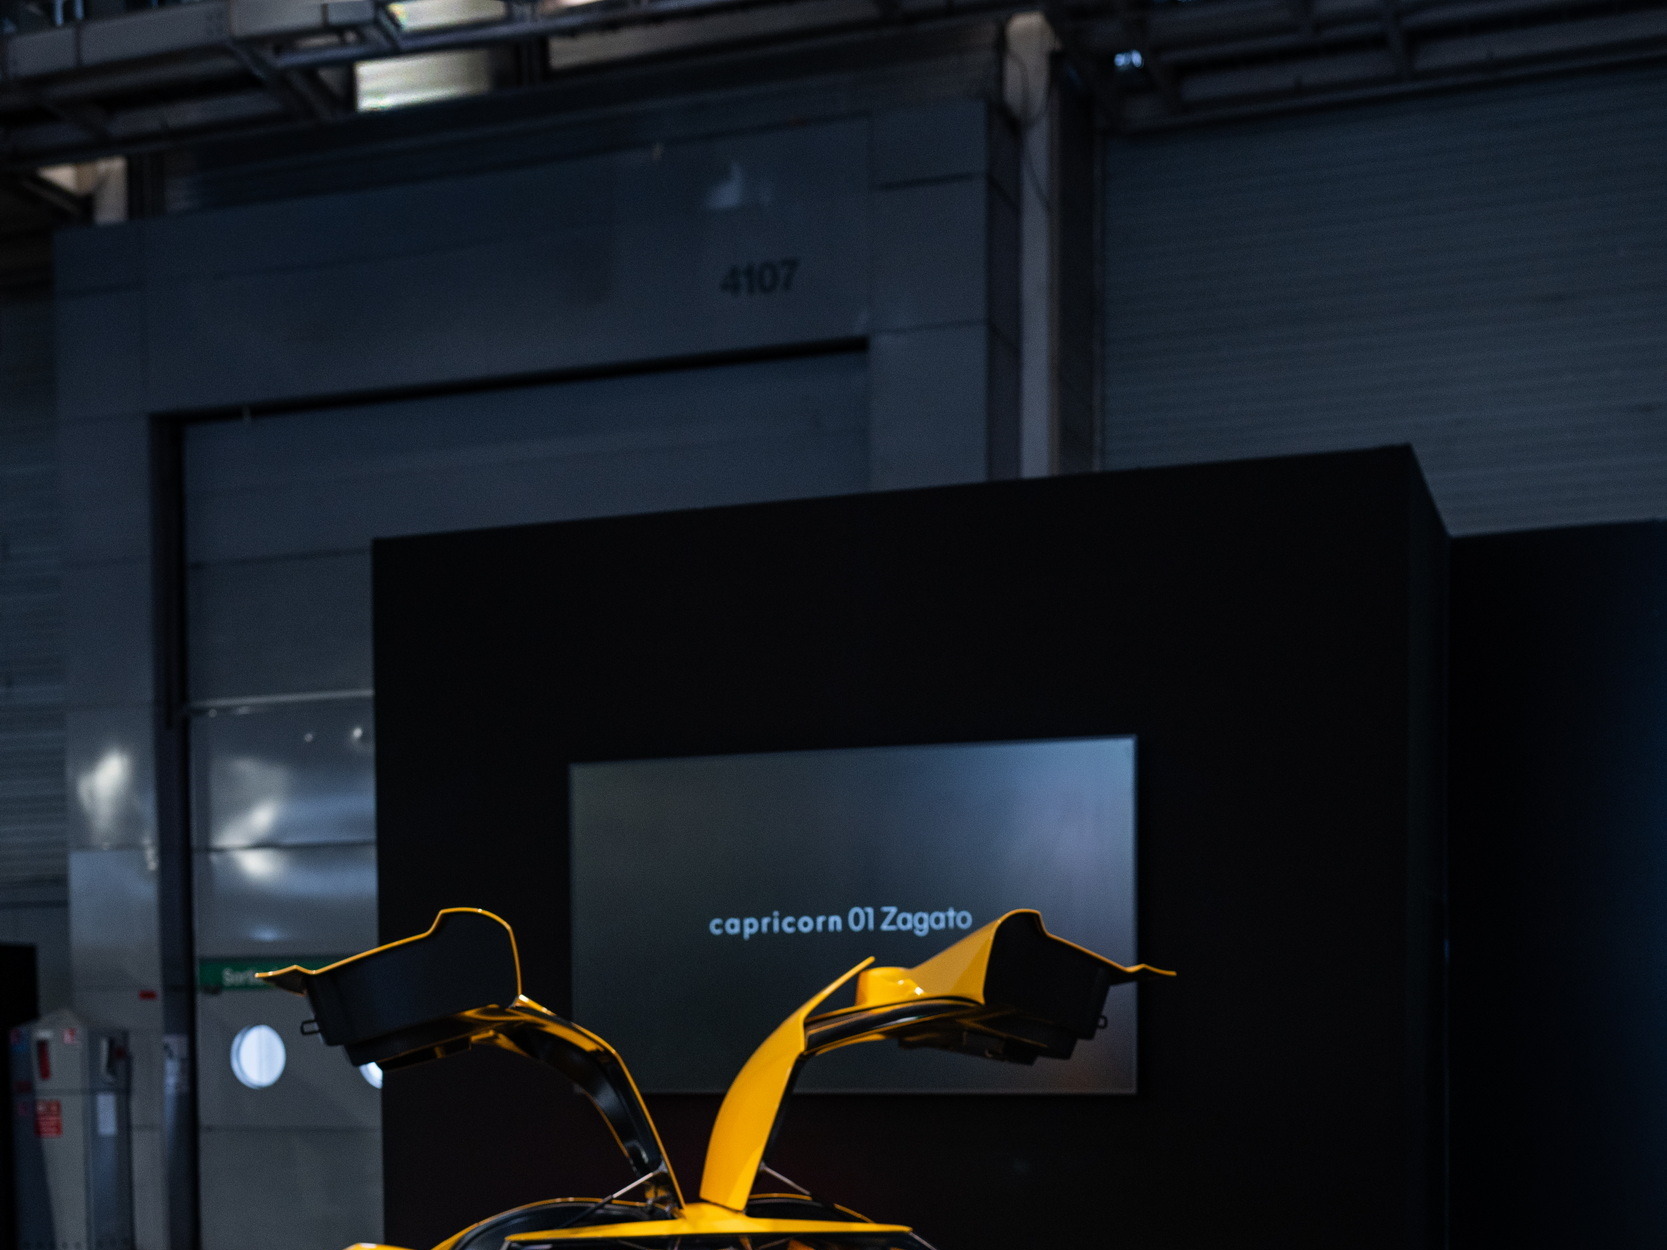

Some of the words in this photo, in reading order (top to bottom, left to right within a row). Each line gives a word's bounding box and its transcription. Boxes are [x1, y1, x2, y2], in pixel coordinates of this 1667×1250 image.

[719, 257, 801, 296] 4107
[709, 910, 843, 940] capricorn
[848, 906, 874, 932] 01
[880, 906, 972, 937] Zagato
